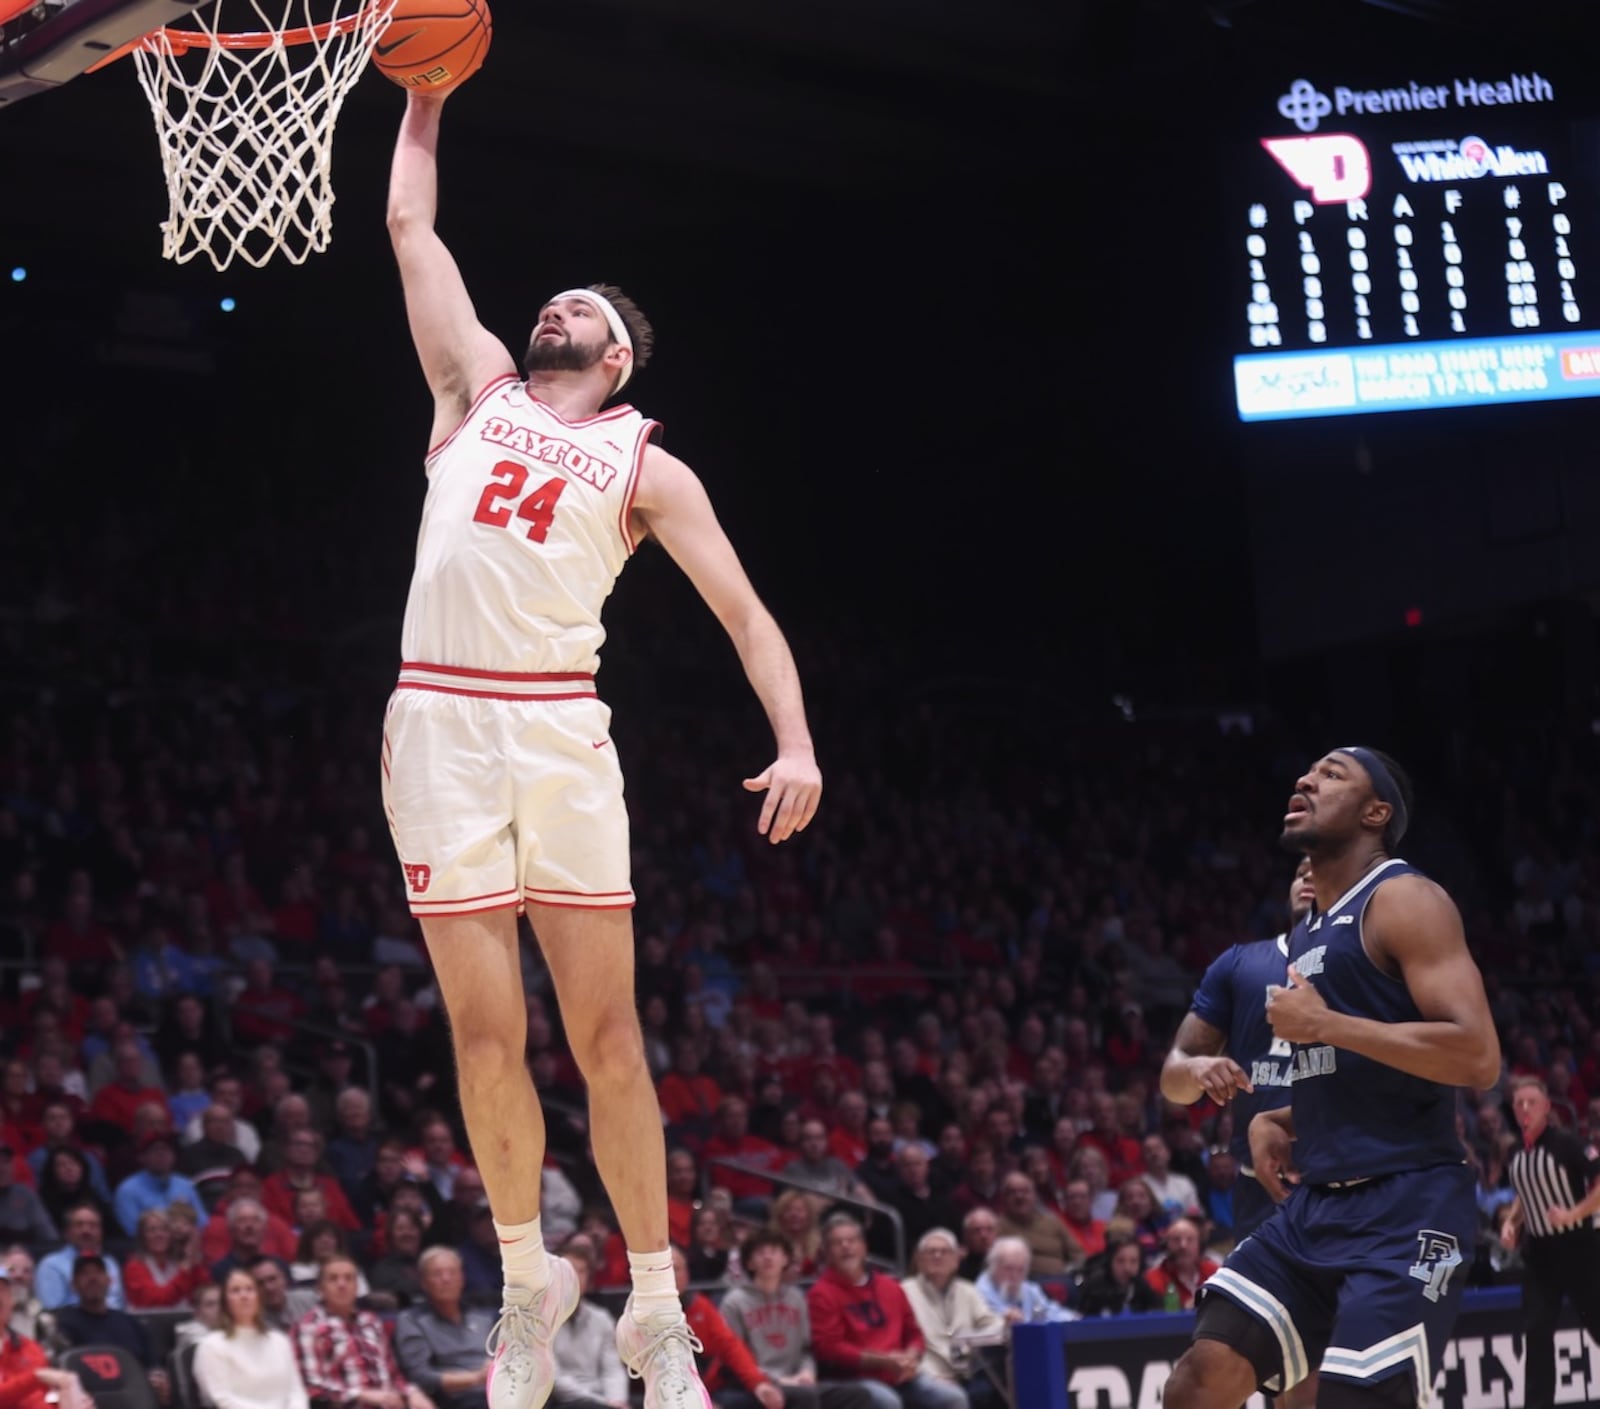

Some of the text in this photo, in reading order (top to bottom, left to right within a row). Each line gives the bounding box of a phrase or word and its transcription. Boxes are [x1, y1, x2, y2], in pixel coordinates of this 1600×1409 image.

[1334, 71, 1554, 116] Premier Health
[1294, 200, 1314, 225] P
[1347, 199, 1369, 221] R
[1393, 193, 1414, 218] A
[1445, 190, 1462, 214] F
[1548, 182, 1567, 206] P
[480, 416, 617, 492] DAYTON
[473, 459, 568, 545] 24
